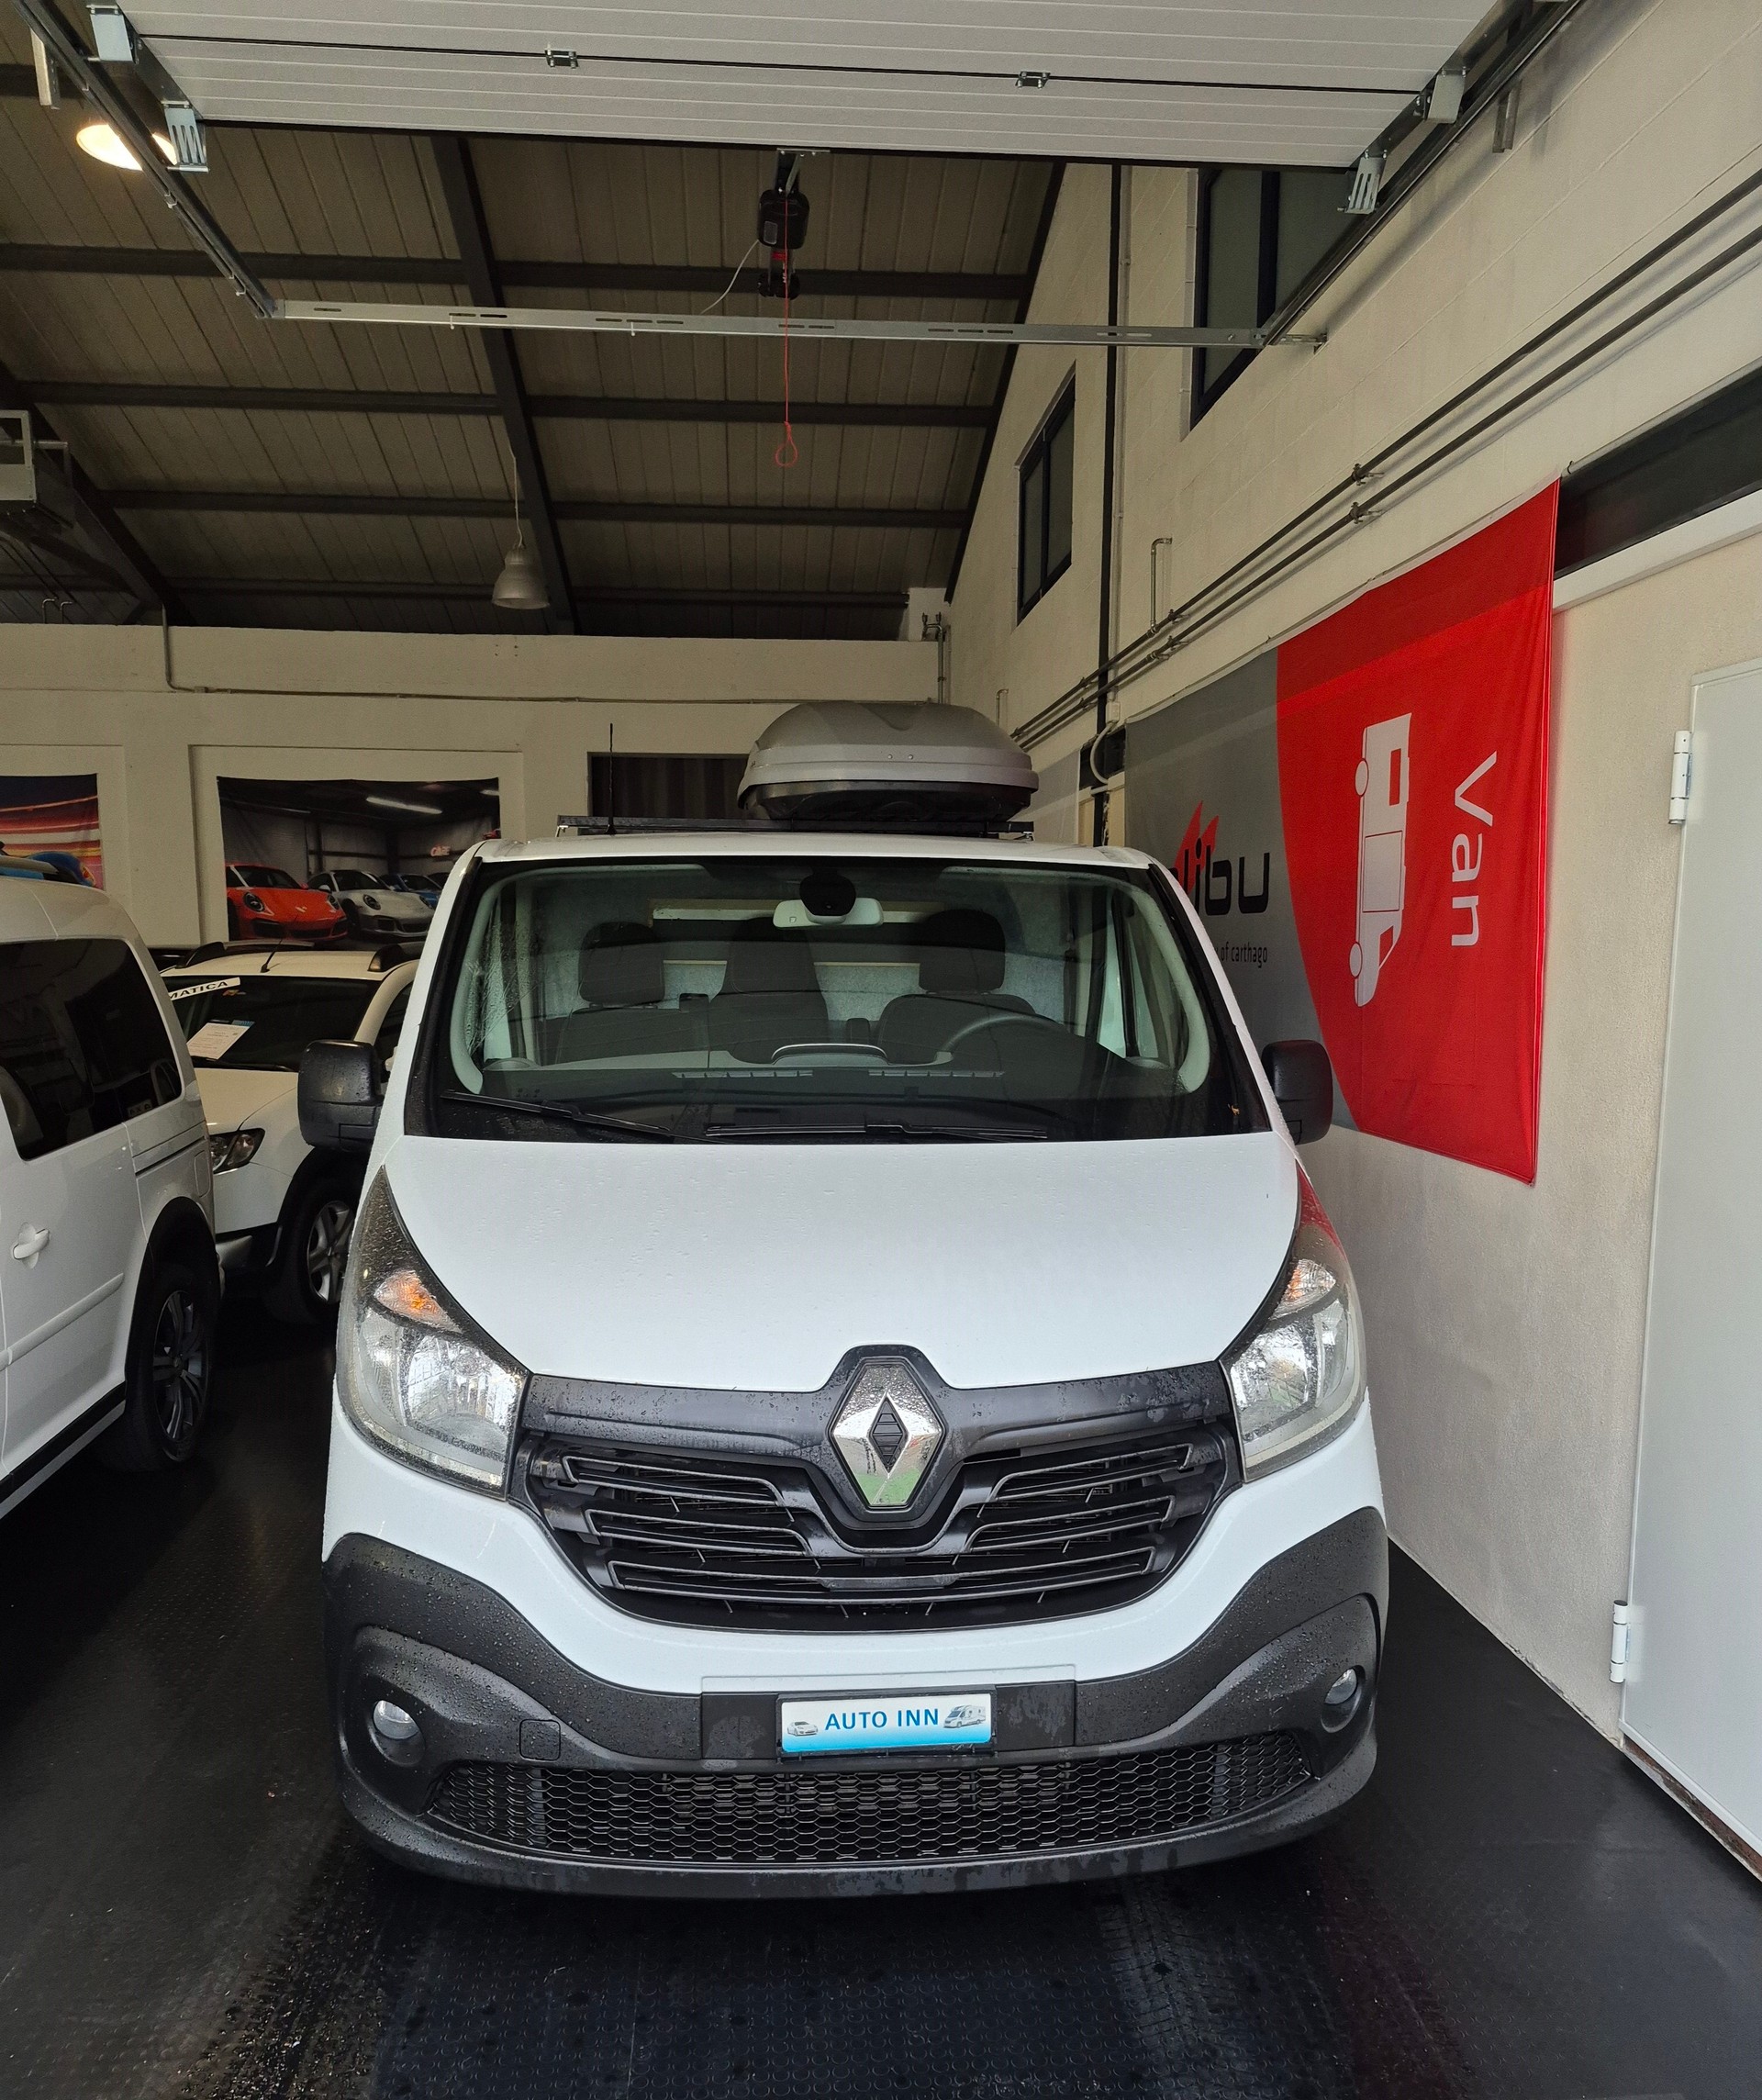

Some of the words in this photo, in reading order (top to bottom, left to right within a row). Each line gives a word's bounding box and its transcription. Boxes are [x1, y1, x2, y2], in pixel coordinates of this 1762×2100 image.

[1450, 750, 1498, 947] Van
[1168, 837, 1270, 916] libu
[1221, 942, 1230, 962] of
[1231, 943, 1268, 968] carthago
[825, 1711, 887, 1731] AUTO
[898, 1708, 939, 1727] INN
